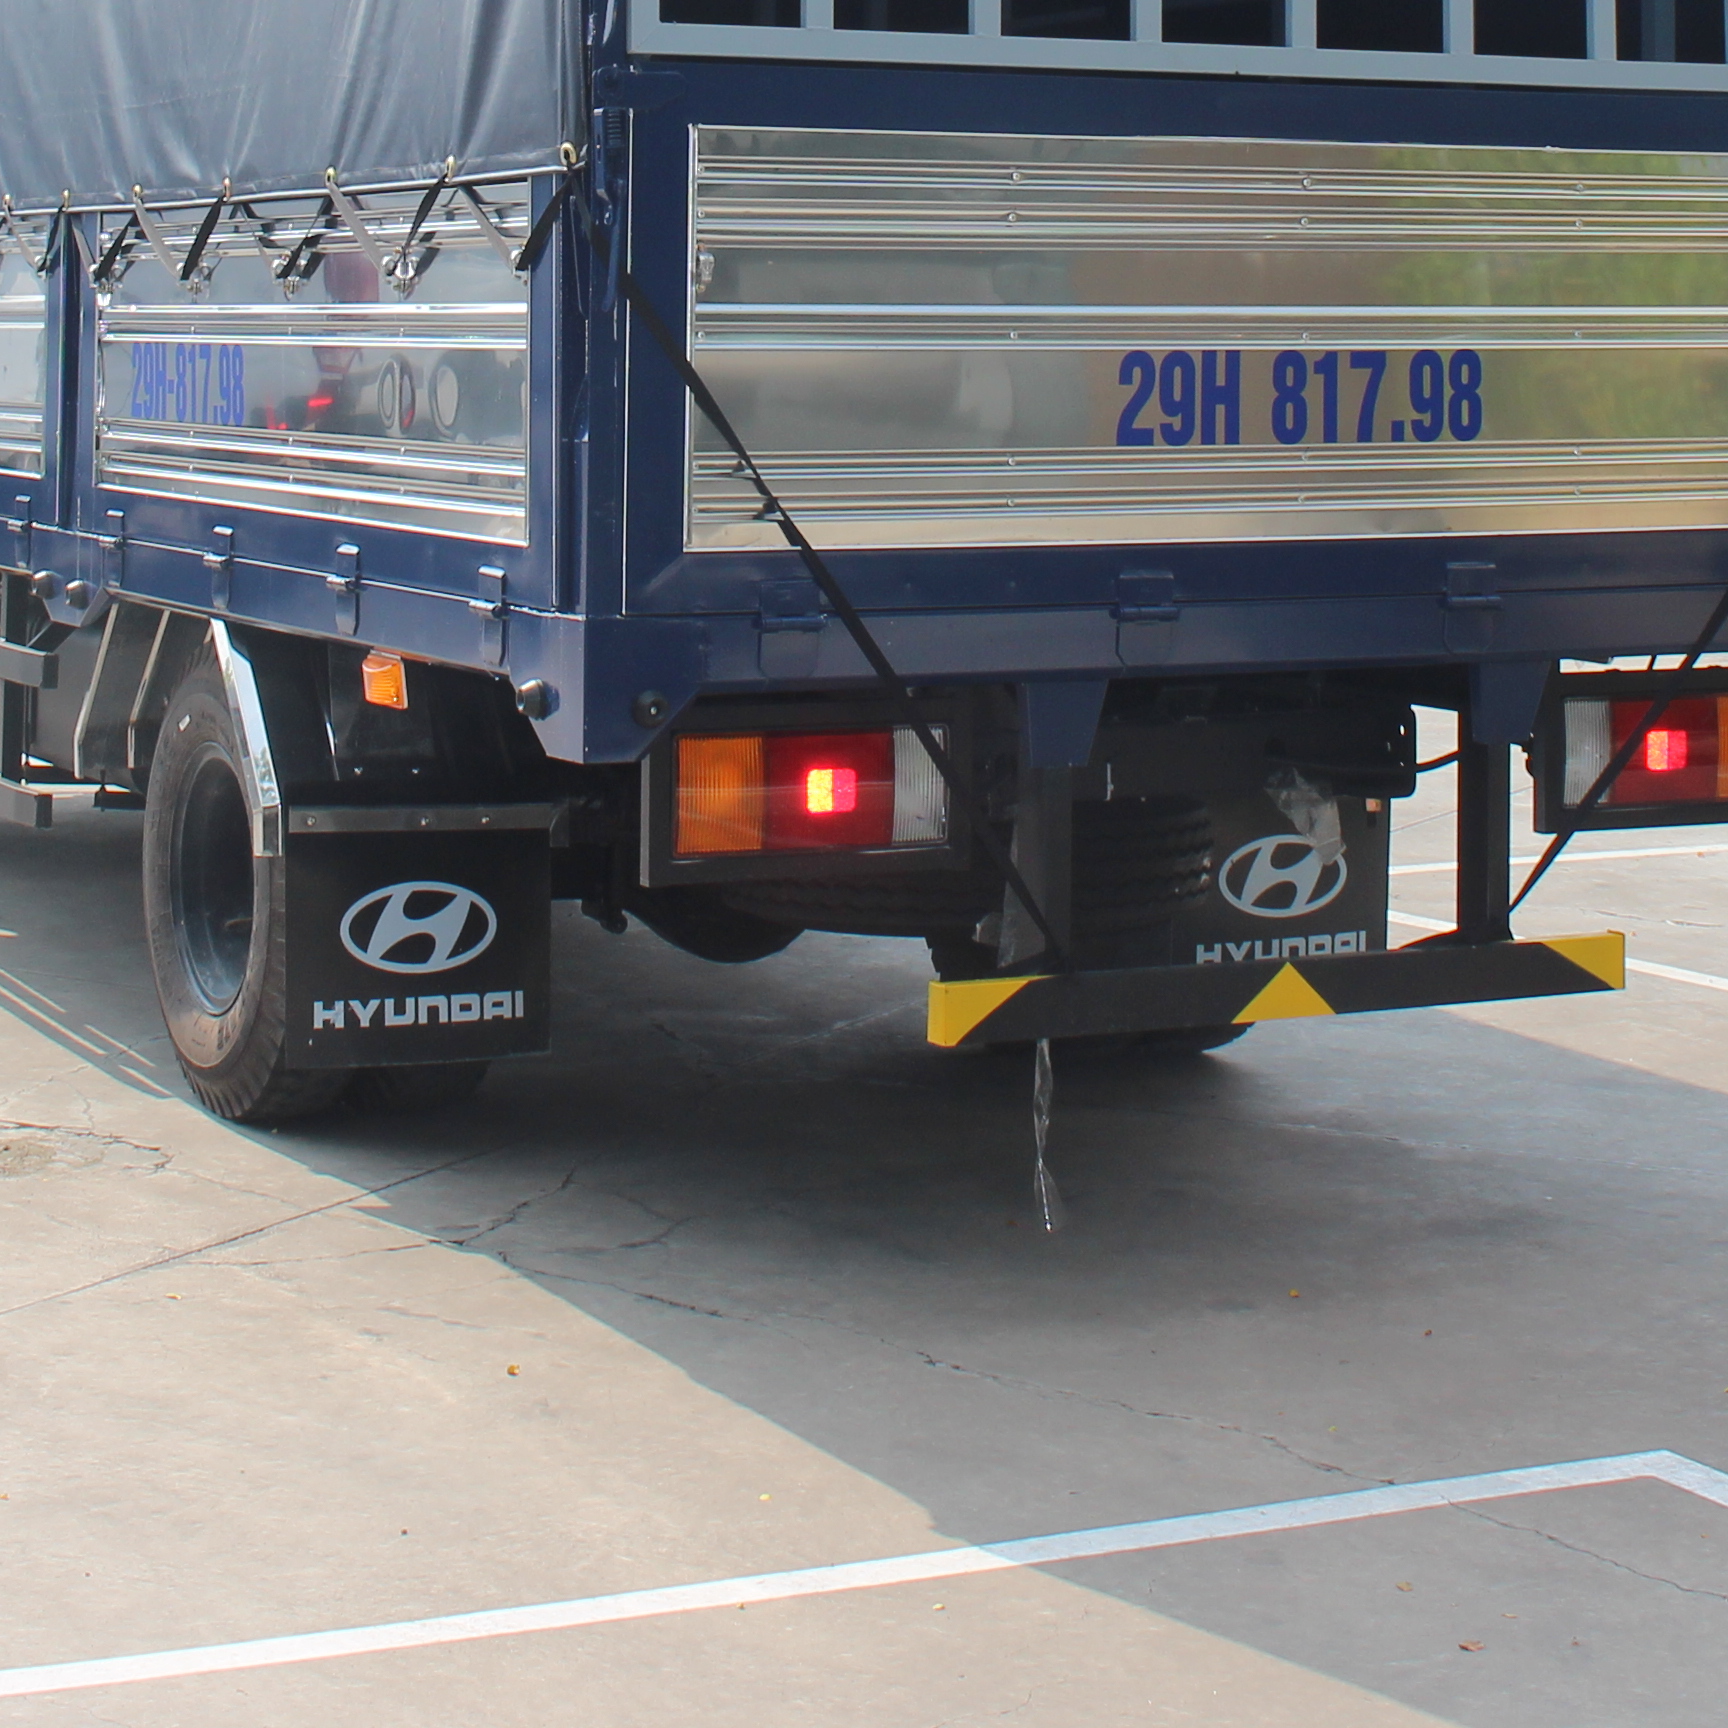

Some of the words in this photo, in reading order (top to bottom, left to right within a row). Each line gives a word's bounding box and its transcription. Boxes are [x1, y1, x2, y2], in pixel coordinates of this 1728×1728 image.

[131, 342, 244, 426] 29H-817.98
[1116, 350, 1241, 446] 29H
[1272, 349, 1483, 445] 817.98
[1196, 930, 1366, 965] HYUNDAI
[313, 990, 524, 1029] HYUNDAI
